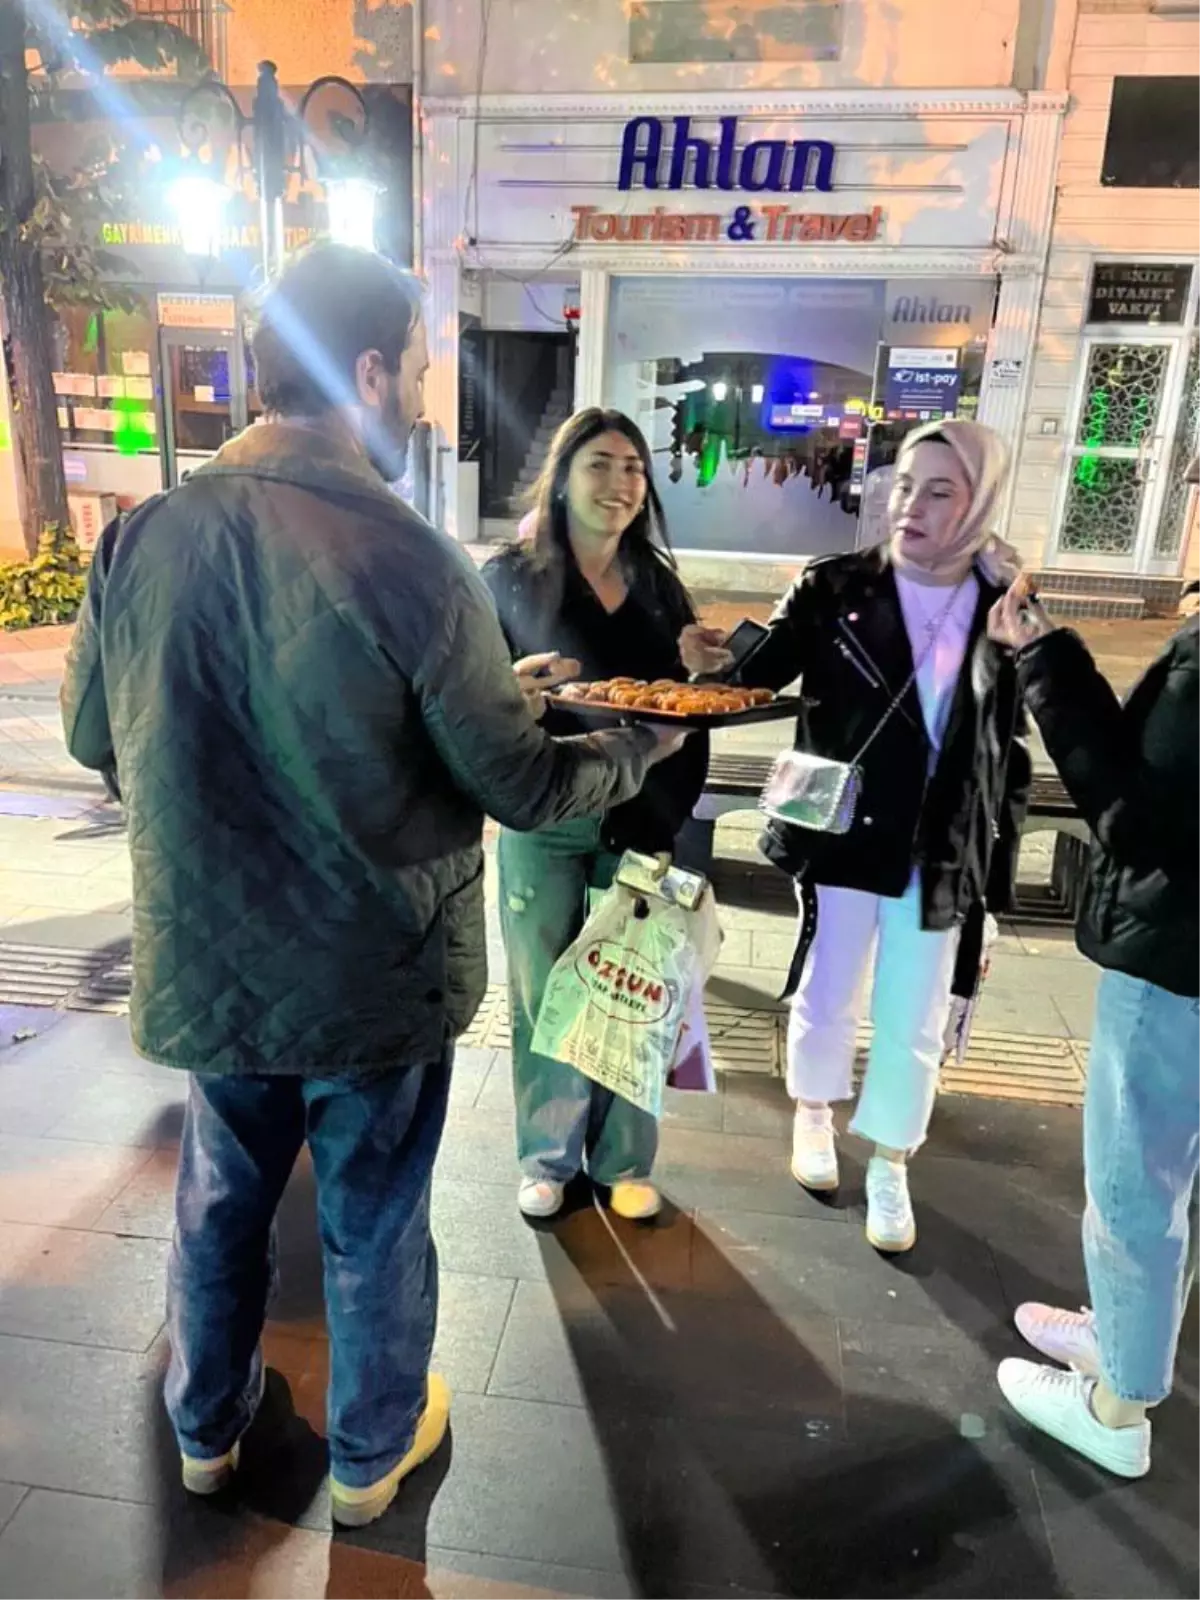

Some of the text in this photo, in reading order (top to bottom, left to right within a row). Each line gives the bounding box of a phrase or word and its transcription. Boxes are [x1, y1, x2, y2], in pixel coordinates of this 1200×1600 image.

[618, 115, 836, 192] Ahlan
[571, 205, 884, 241] Tourism & Travel
[892, 296, 972, 323] Ahlan
